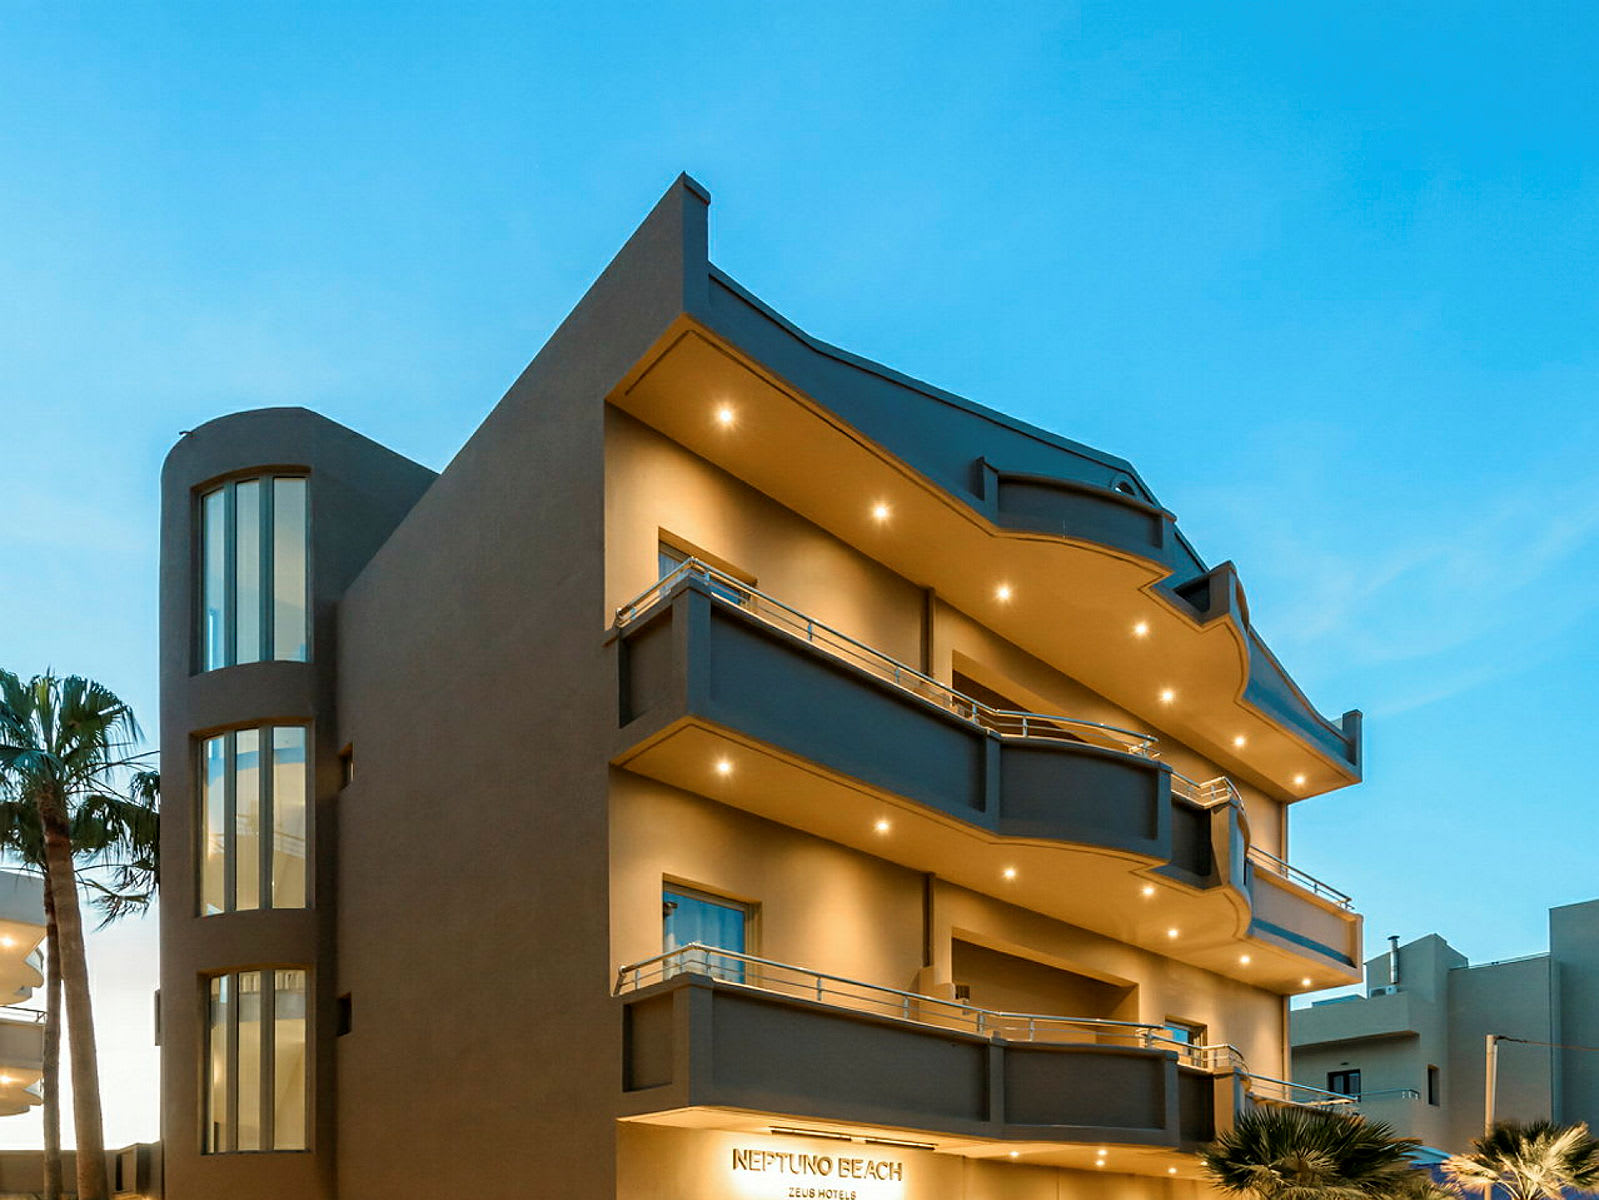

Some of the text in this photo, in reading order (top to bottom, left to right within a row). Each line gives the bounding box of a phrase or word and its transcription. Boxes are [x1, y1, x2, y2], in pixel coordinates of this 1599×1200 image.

[733, 1148, 902, 1181] NEPTUNO BEACH
[788, 1187, 857, 1200] ZEUS HOTELS
